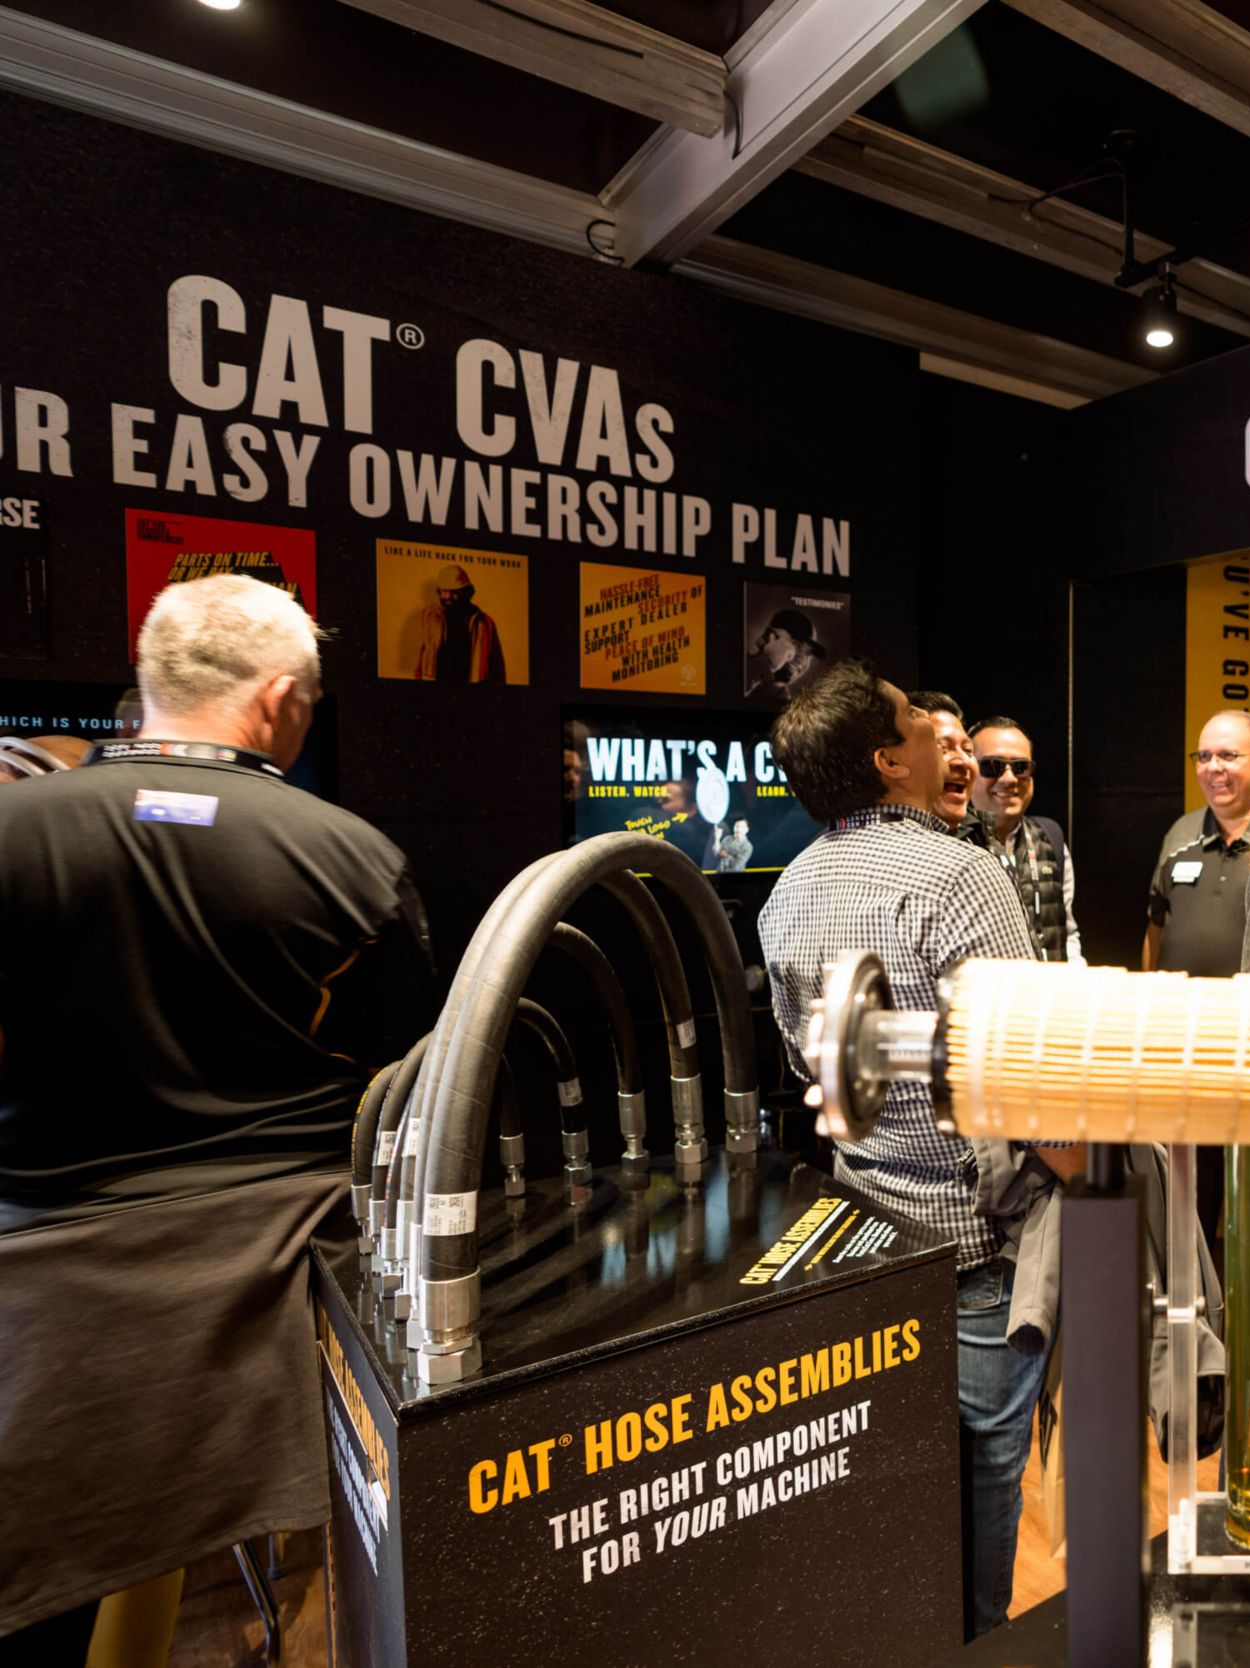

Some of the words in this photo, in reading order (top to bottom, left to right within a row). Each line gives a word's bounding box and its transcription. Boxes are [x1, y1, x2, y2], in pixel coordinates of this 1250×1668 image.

[0, 385, 74, 478] R
[111, 402, 321, 509] EASY
[349, 443, 712, 558] OWNERSHIP
[732, 502, 851, 577] PLAN
[174, 553, 211, 567] PARTS
[213, 553, 230, 567] ON
[385, 546, 403, 556] LIKE
[414, 548, 432, 560] LIFE
[435, 552, 456, 561] HACK
[459, 554, 474, 564] FOR
[478, 556, 497, 566] YOUR
[584, 584, 661, 618] MAINTENANCE
[637, 591, 688, 614] SECURITY
[690, 584, 703, 599] OF
[584, 617, 633, 641] EXPERT
[640, 601, 687, 625] DEALER
[584, 630, 630, 655] SUPPORT
[605, 640, 639, 660] PEACE
[642, 635, 654, 649] OF
[658, 625, 685, 643] MIND
[622, 650, 649, 667] WITH
[652, 635, 690, 657] HEALTH
[611, 650, 679, 683] MONITORING
[53, 717, 70, 728] IS
[79, 718, 124, 729] YOUR
[726, 741, 747, 782] A
[588, 785, 630, 797] LISTEN.
[584, 1393, 695, 1475] HOSE
[706, 1318, 921, 1433] ASSEMBLIES
[549, 1506, 609, 1551] THE
[620, 1461, 707, 1525] RIGHT
[716, 1400, 872, 1486] COMPONENT
[581, 1533, 641, 1584] FOR
[652, 1496, 728, 1554] YOUR
[737, 1446, 851, 1521] MACHINE
